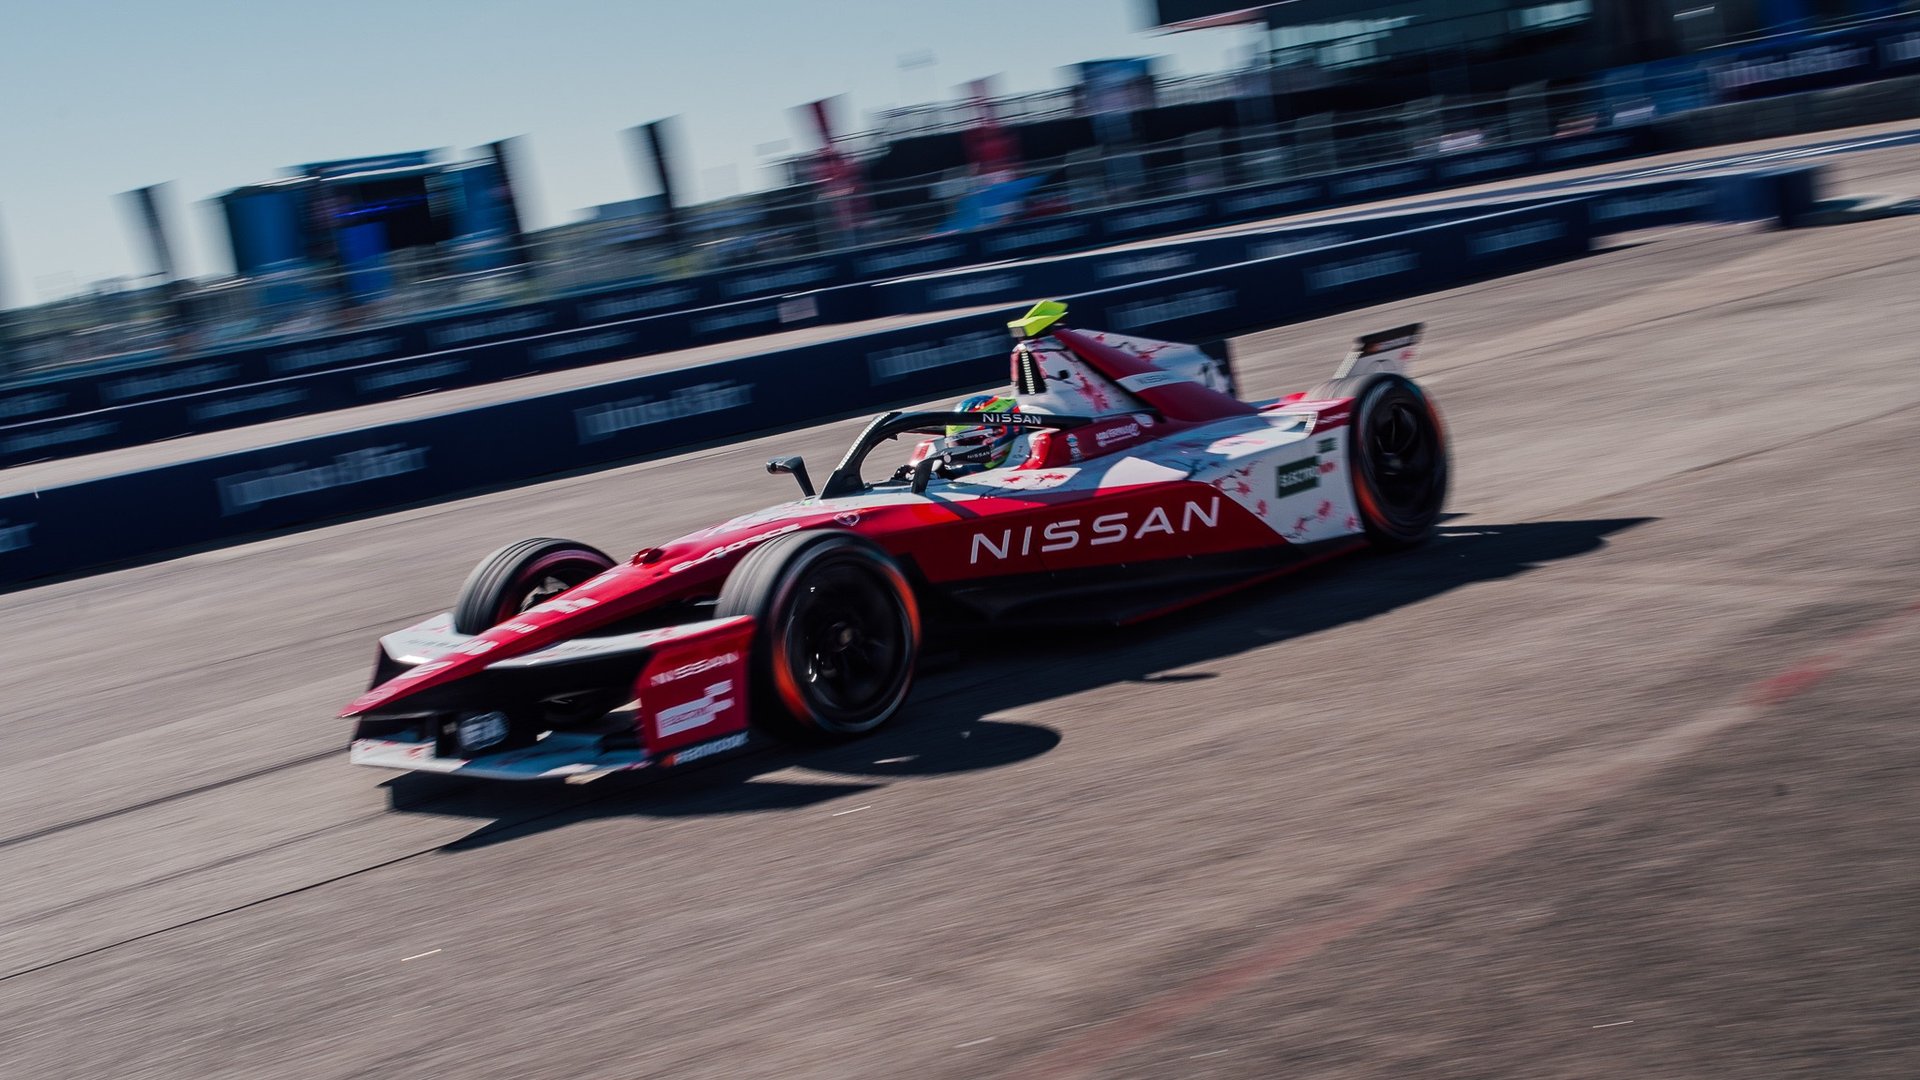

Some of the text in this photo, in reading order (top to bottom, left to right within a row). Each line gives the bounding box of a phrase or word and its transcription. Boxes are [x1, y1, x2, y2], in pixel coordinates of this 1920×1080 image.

[982, 413, 1041, 425] NISSAN
[967, 451, 991, 460] NISSAN
[970, 497, 1221, 564] NISSAN
